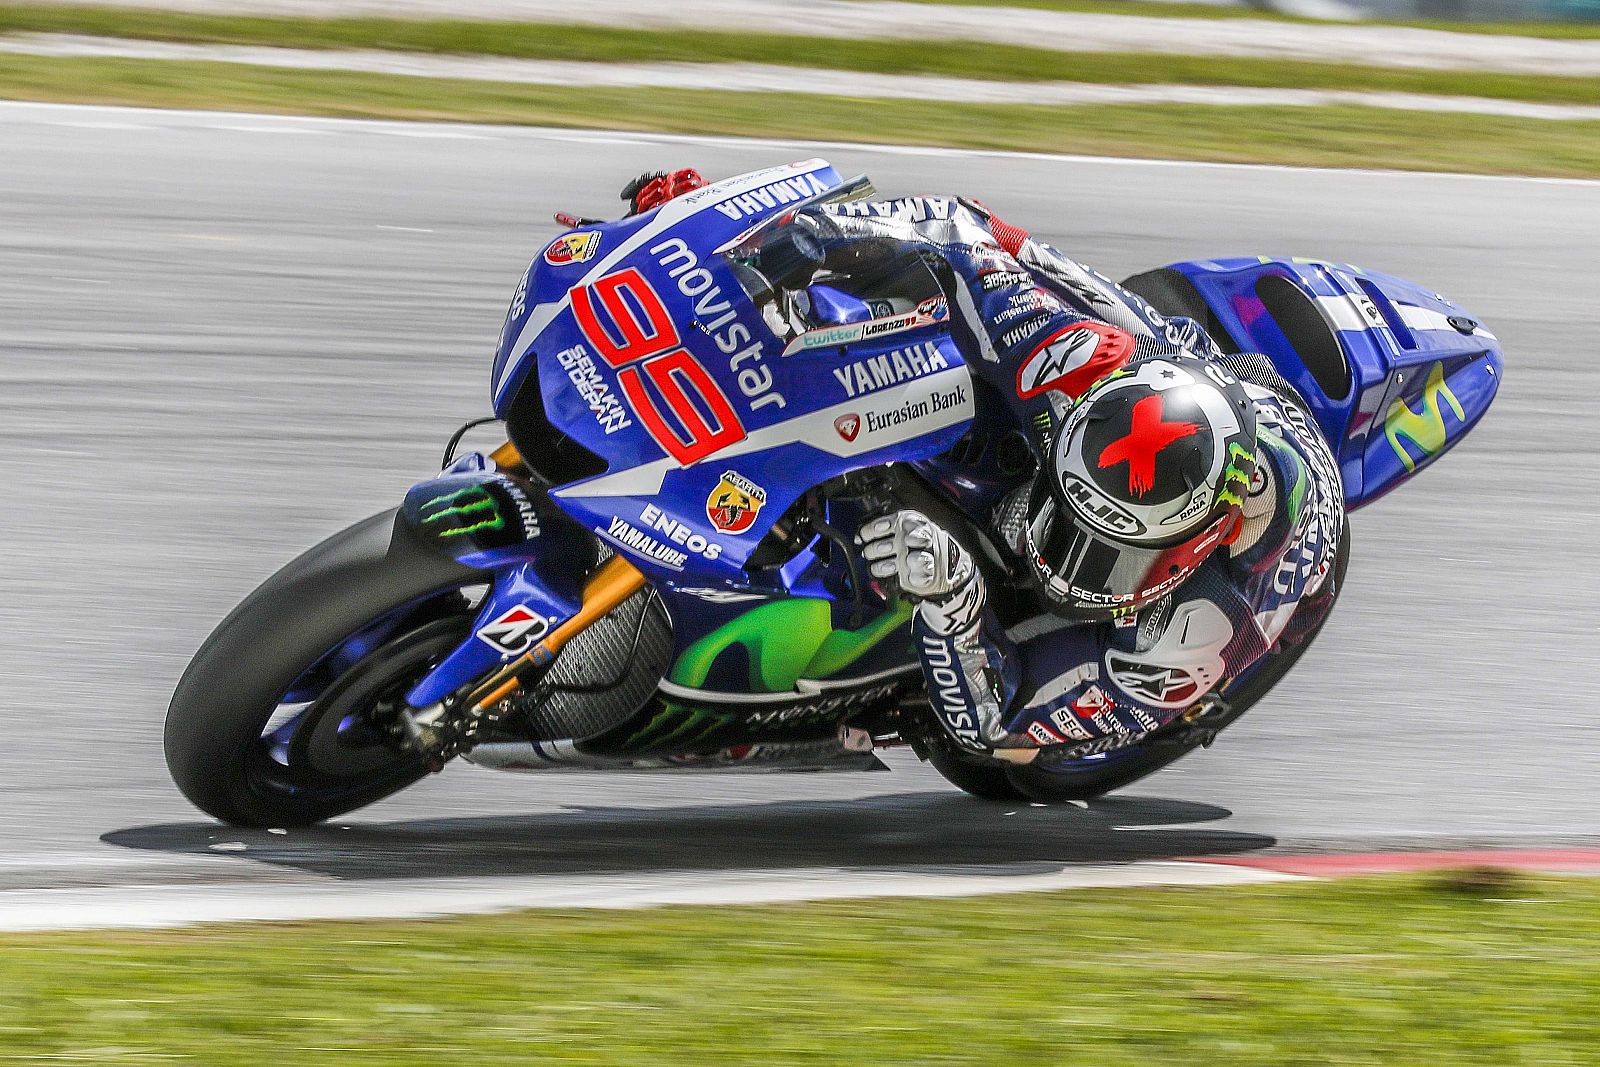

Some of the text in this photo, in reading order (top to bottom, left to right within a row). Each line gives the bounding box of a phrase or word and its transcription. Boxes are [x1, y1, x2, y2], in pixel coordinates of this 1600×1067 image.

[714, 172, 829, 221] YAMAHA
[650, 237, 786, 411] movistar
[804, 329, 860, 346] twitter
[567, 266, 748, 467] 99
[567, 343, 632, 432] SEMAKIN
[833, 341, 948, 398] YAMAHA
[865, 385, 966, 432] Eurasian Bank
[1067, 479, 1136, 530] HJC
[1179, 499, 1206, 521] RPHA
[607, 515, 688, 567] YAMALUBE
[640, 503, 722, 560] ENEOS
[1070, 585, 1135, 603] SECTOR
[1141, 565, 1189, 598] SECTOR
